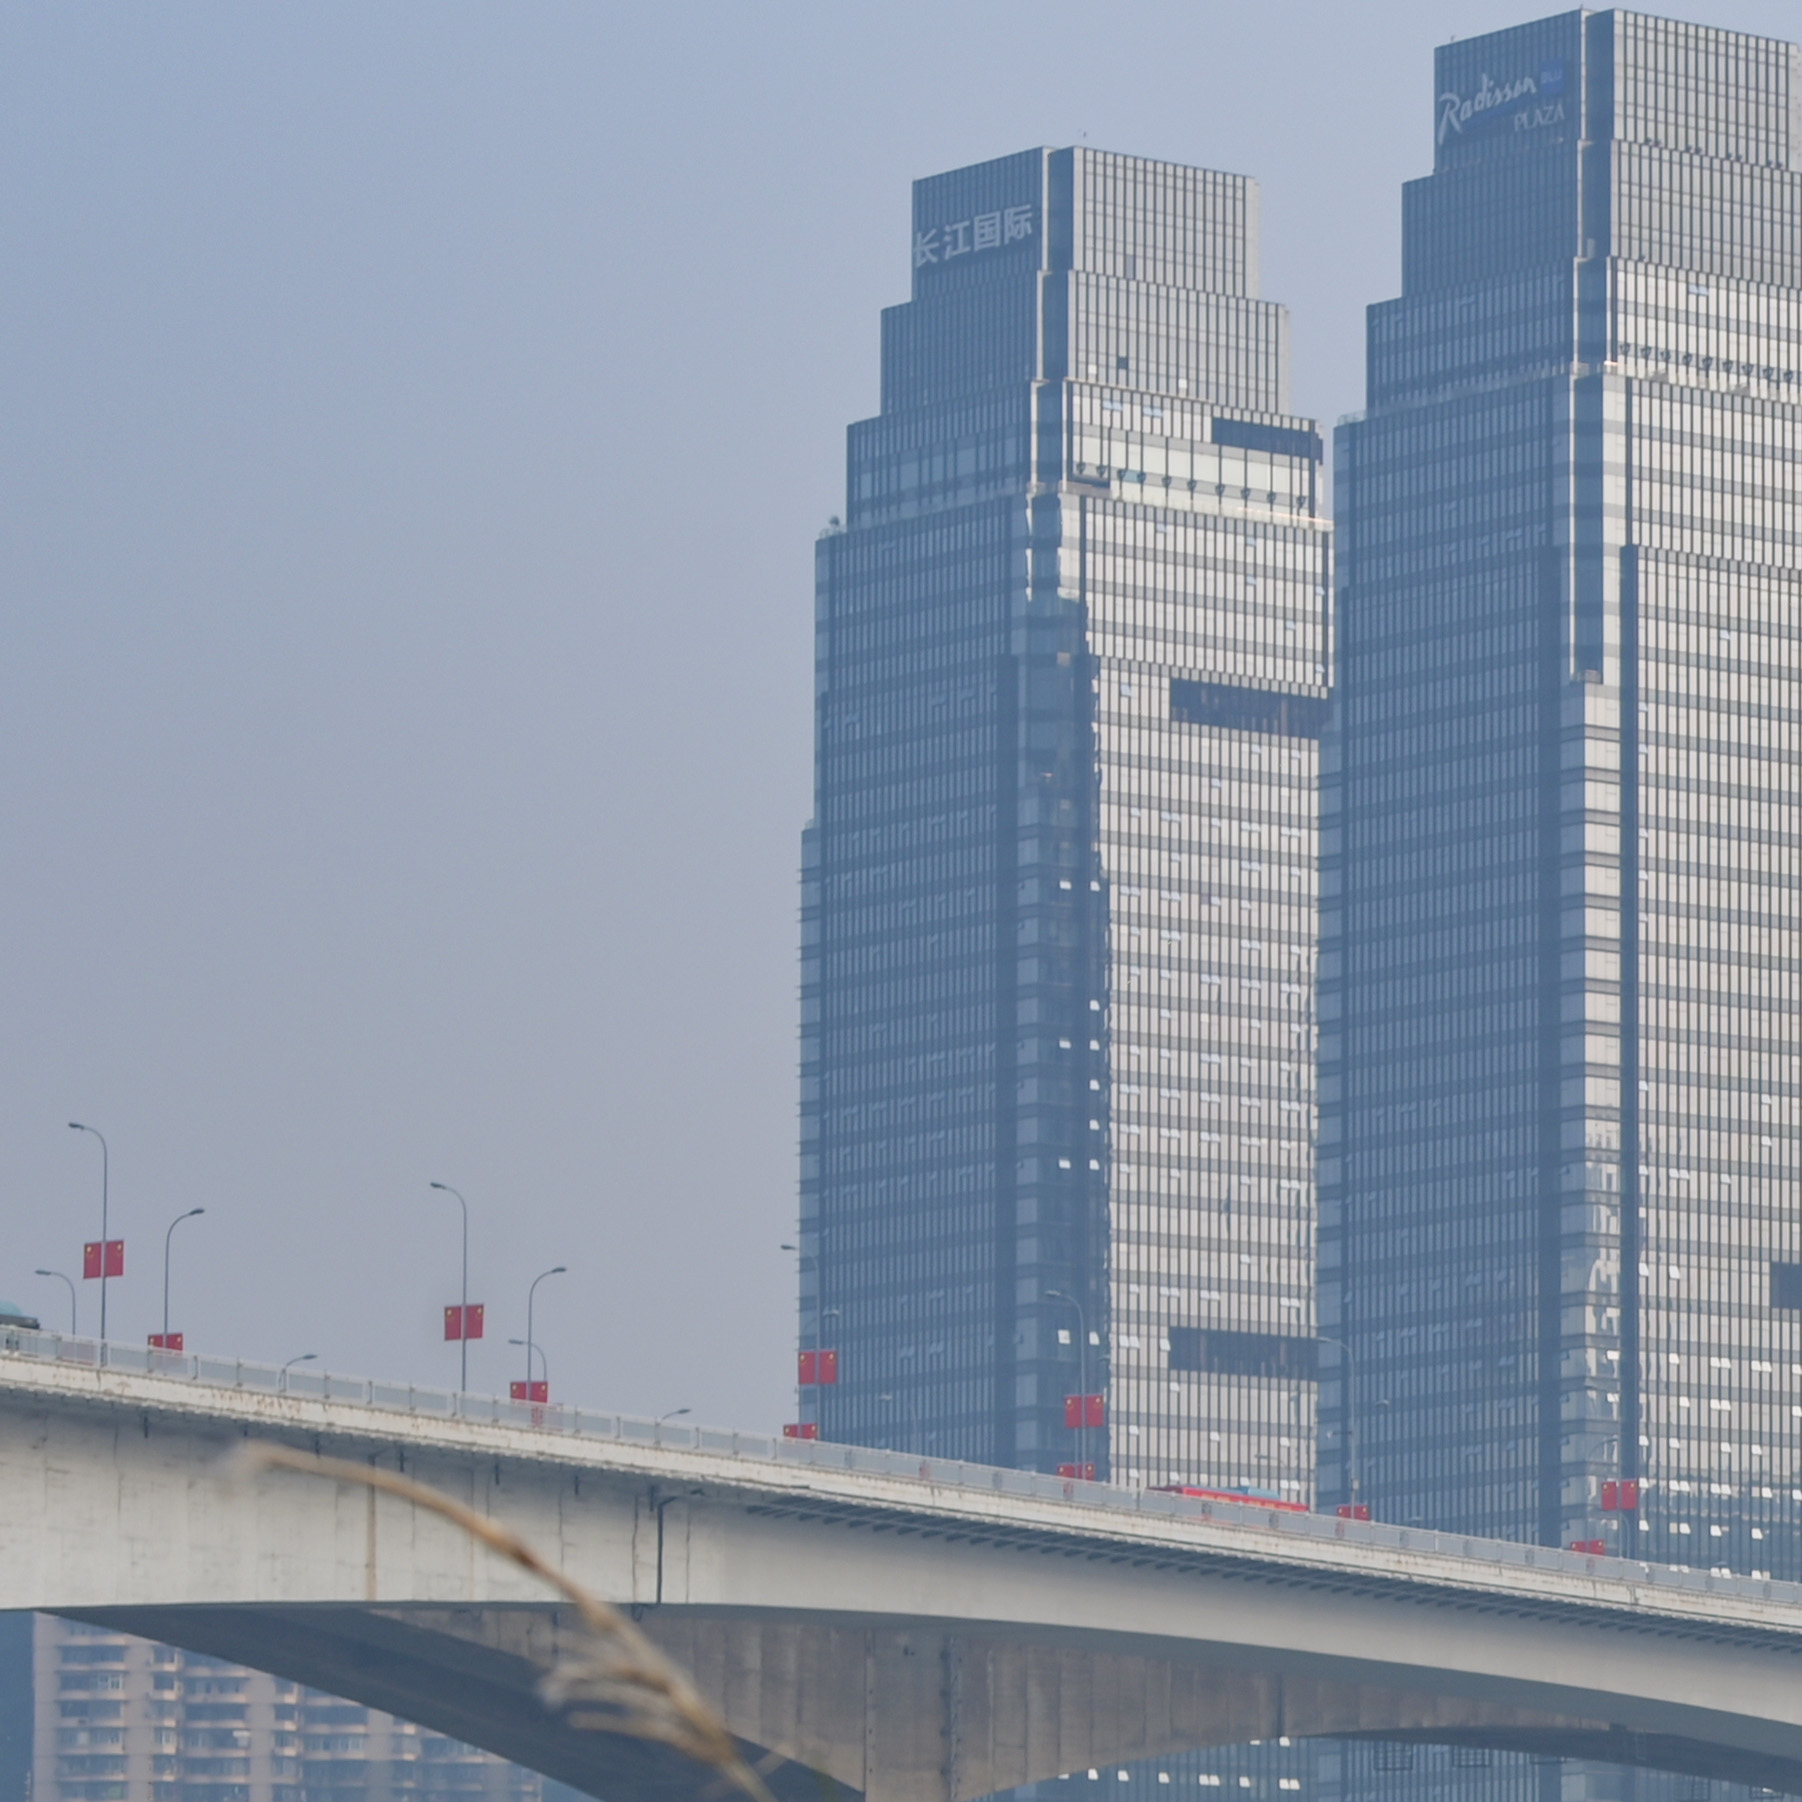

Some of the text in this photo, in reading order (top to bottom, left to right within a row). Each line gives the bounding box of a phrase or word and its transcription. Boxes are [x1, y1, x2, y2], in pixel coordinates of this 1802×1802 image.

[1438, 73, 1537, 145] Radisson
[1514, 103, 1565, 132] PLAZA
[913, 204, 1033, 268] 长江国际
